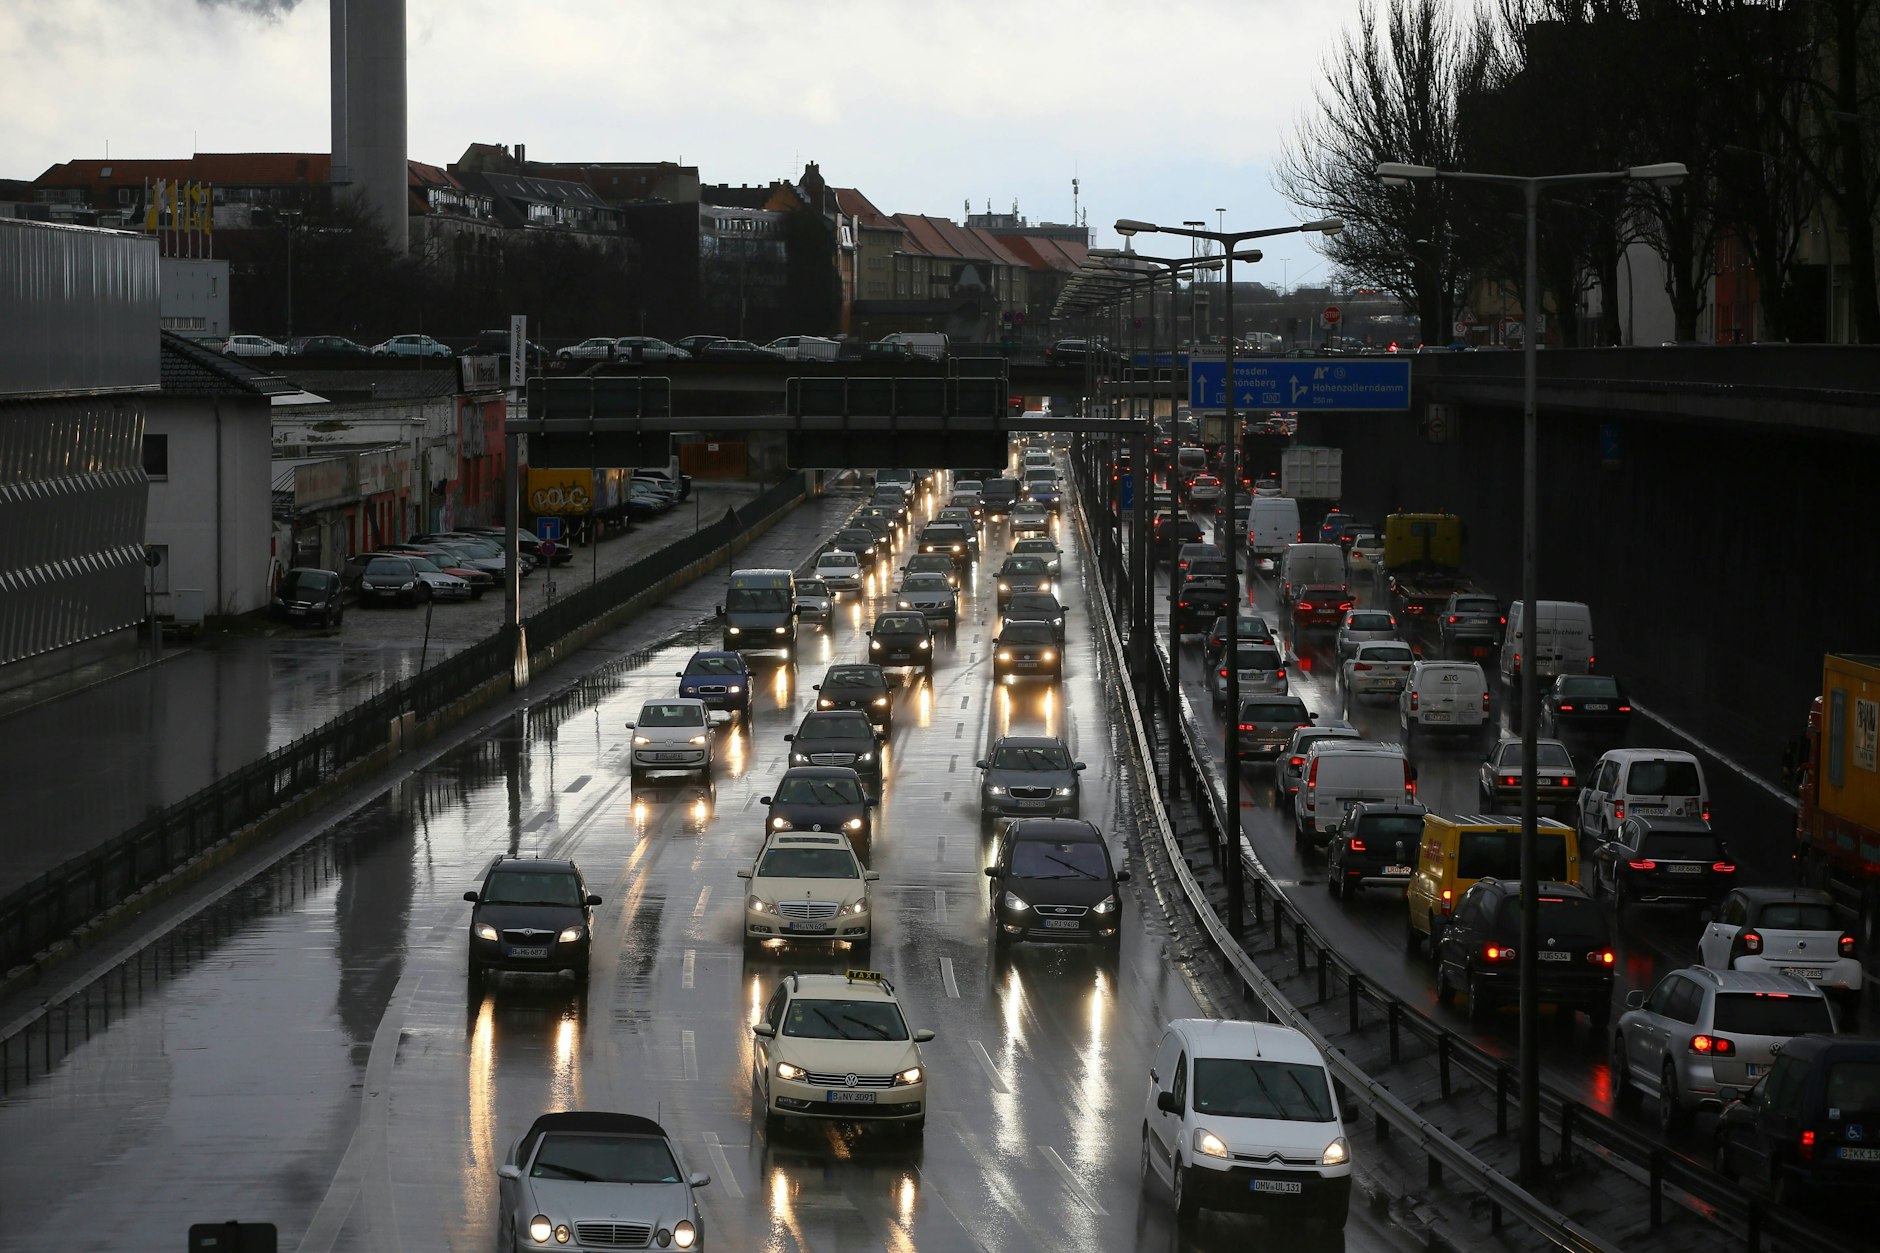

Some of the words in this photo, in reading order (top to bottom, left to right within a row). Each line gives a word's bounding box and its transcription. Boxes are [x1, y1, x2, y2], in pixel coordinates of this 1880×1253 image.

[1325, 311, 1340, 319] STOP
[1221, 377, 1276, 388] Shöneberg
[1313, 383, 1404, 392] Hohenzollerndamm
[853, 971, 876, 980] TAXI
[832, 1092, 838, 1100] B
[1841, 1148, 1848, 1157] B
[1853, 1149, 1865, 1158] KK
[1255, 1181, 1270, 1190] OHV
[1286, 1183, 1300, 1192] 131
